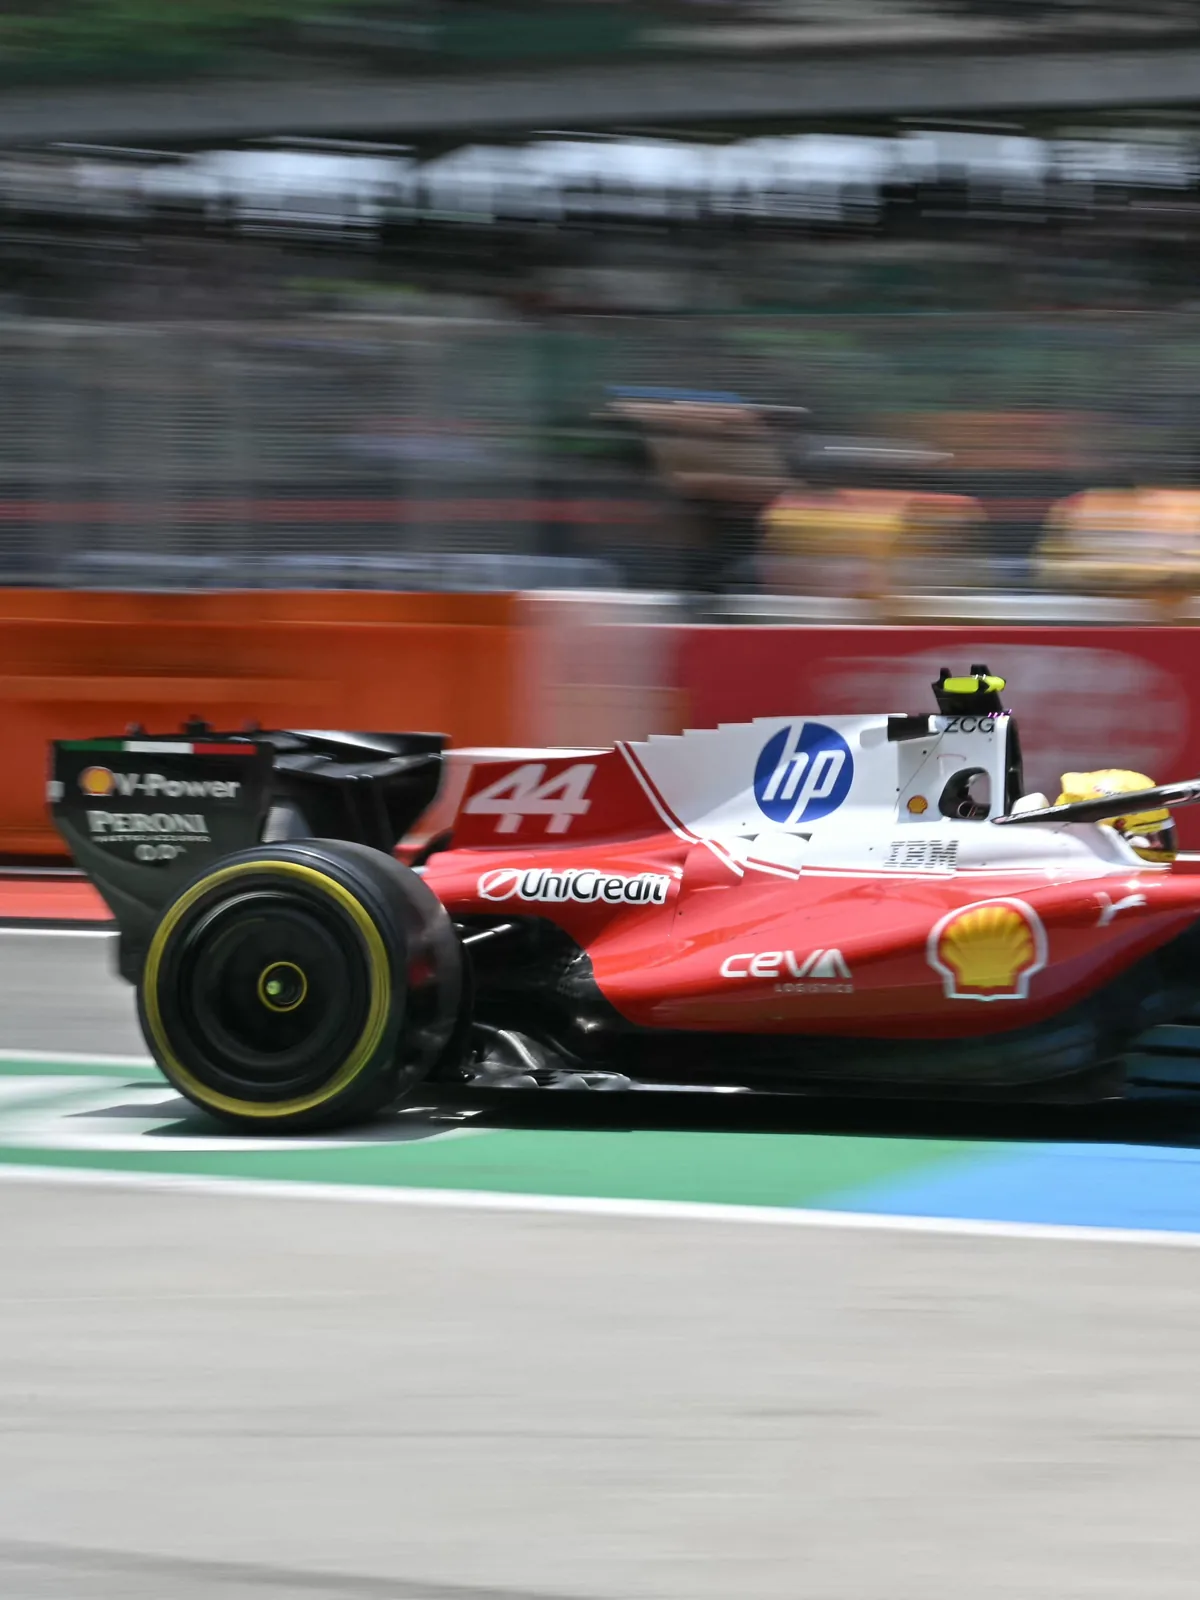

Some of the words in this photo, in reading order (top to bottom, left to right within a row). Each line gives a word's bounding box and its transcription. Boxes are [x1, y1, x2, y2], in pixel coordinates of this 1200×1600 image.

[944, 716, 995, 733] ZCG
[113, 772, 241, 798] V-Power
[761, 722, 847, 824] hp
[462, 763, 598, 834] 44
[86, 810, 209, 834] PERONI
[883, 839, 960, 869] IBM
[520, 872, 665, 902] UniCredit
